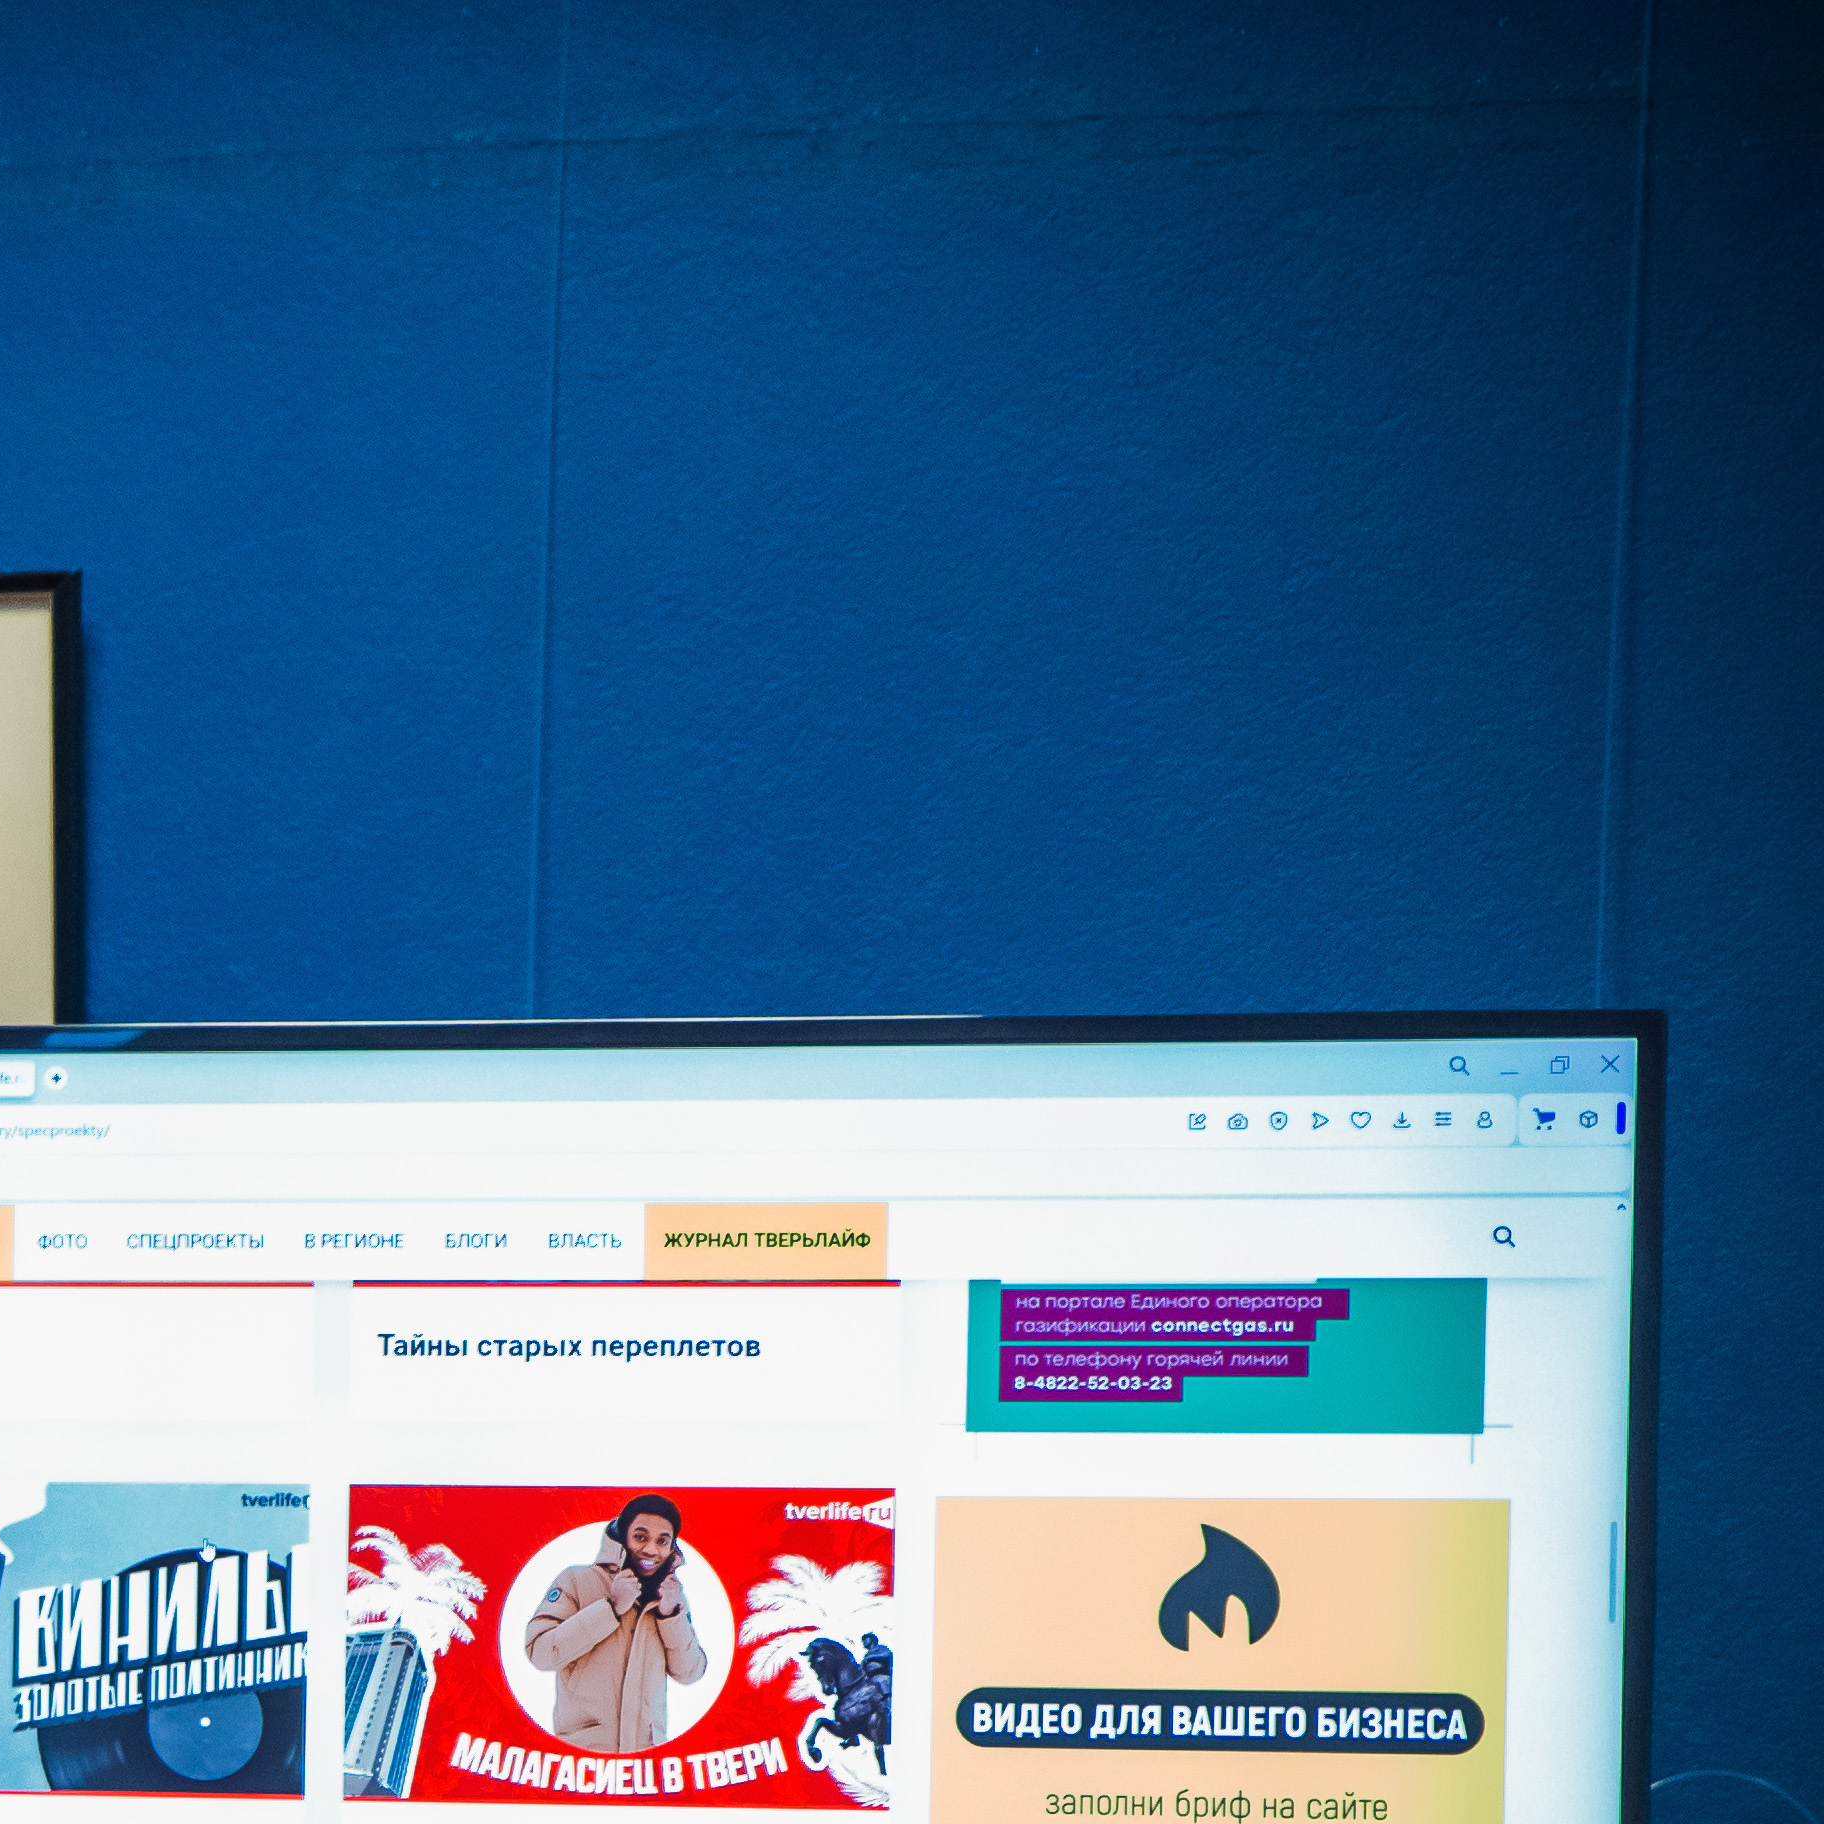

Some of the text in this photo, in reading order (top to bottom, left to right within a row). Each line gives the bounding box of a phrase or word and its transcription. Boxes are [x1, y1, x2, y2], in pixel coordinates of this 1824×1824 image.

[38, 1234, 88, 1249] ФОТО
[127, 1233, 264, 1252] СПЕЦПРОЕКТЫ
[305, 1233, 405, 1249] В РЕГИОНЕ
[445, 1233, 508, 1249] БЛОГИ
[549, 1233, 622, 1249] ВЛАСТЬ
[664, 1228, 871, 1248] ЖУРНАЛ ТВЕРЬЛАЙФ
[1016, 1294, 1322, 1312] на портале Единого оператора
[1015, 1319, 1294, 1337] газификации connectgas.ru
[378, 1333, 761, 1362] Тайны старых переплетов
[1015, 1351, 1288, 1370] по телефону горячей линии
[1013, 1376, 1173, 1391] 8-4822-52-03-23
[15, 1543, 309, 1680] ВИНИЛЫ
[14, 1668, 144, 1724] ЗОЛОТЫЕ
[972, 1702, 1468, 1740] ВИДЕО ДЛЯ ВАШЕГО БИЗНЕСА
[451, 1732, 787, 1795] МАЛАГАСИЕЦ В ТВЕРИ
[1046, 1789, 1388, 1824] заполни бриф на сайте
